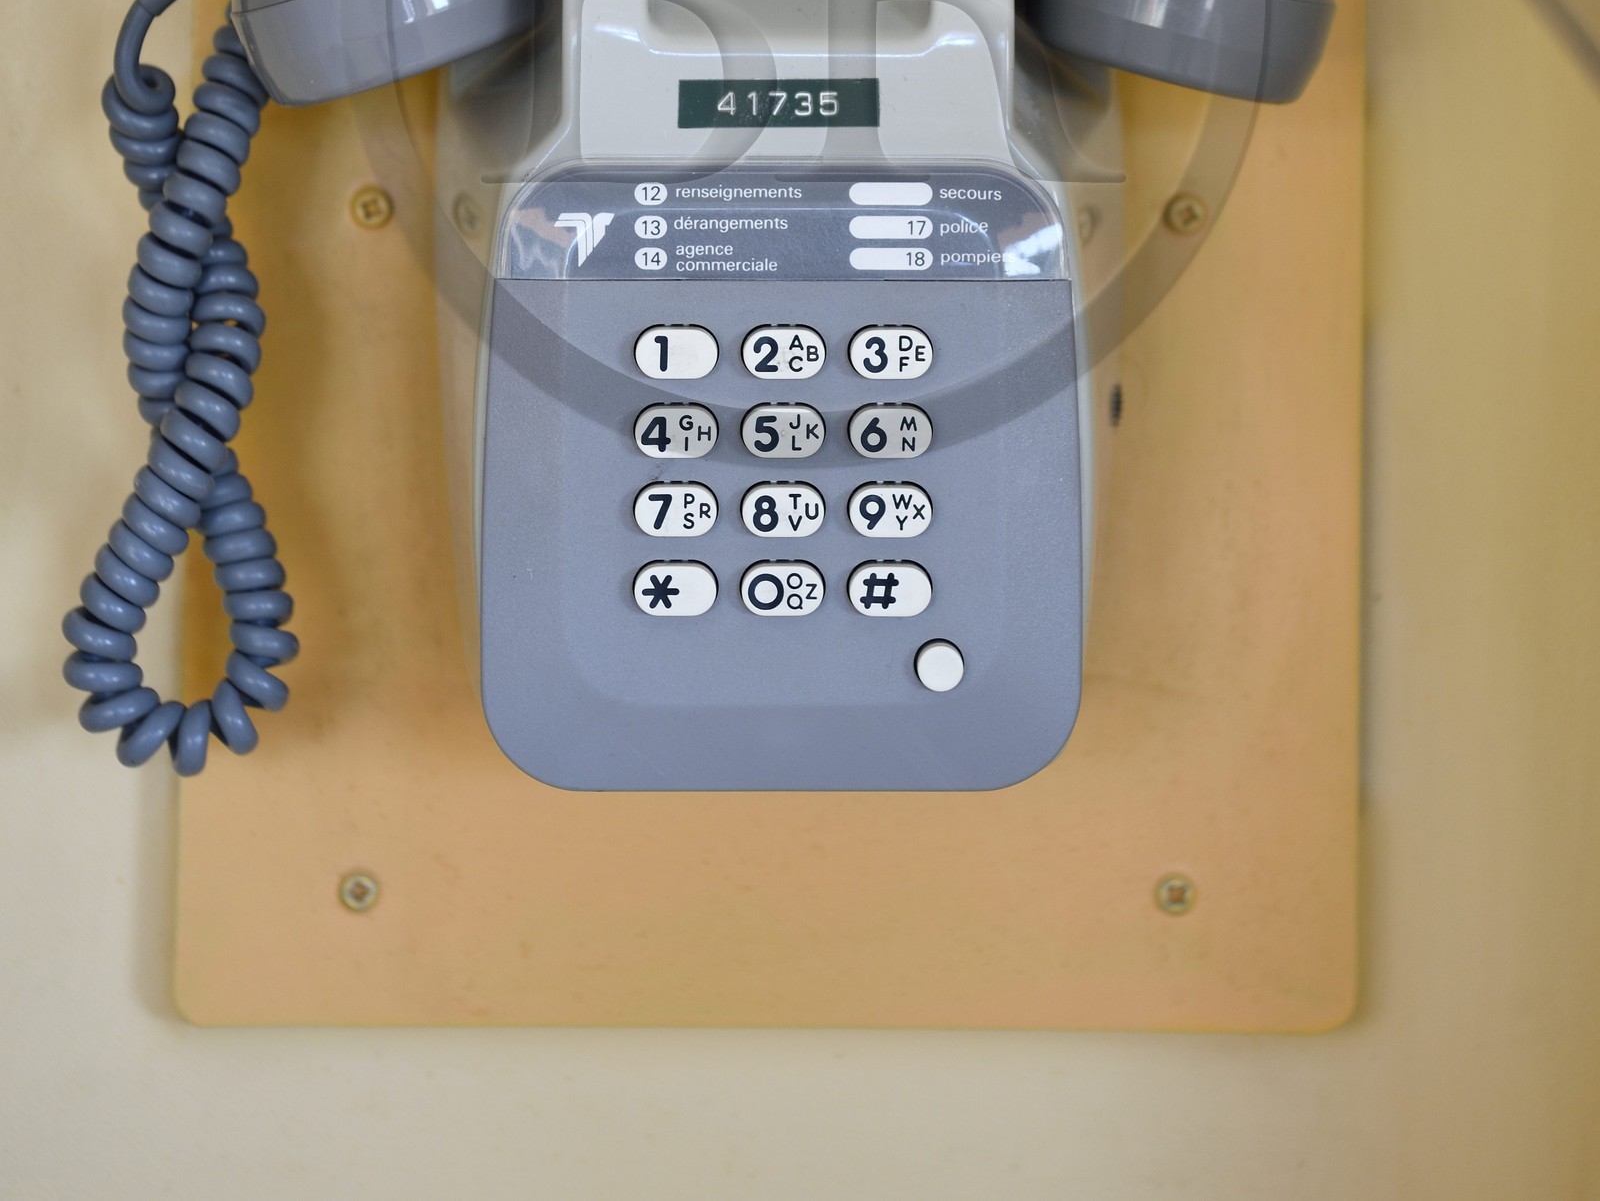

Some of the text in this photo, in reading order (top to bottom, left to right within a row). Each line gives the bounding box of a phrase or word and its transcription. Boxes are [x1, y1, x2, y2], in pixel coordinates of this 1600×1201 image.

[717, 90, 838, 117] 41735
[642, 185, 803, 202] 12 renseignements
[939, 187, 1003, 201] secours
[642, 216, 789, 236] 13 dérangements
[907, 219, 989, 237] 17 police
[642, 244, 734, 266] 14 agence
[675, 257, 779, 272] commerciale
[906, 251, 926, 267] 18
[654, 335, 669, 372] 1
[753, 336, 779, 373] 2
[863, 336, 888, 374] 3
[640, 416, 672, 453] 4
[753, 415, 780, 453] 5
[860, 417, 888, 453] 6
[648, 493, 673, 530] 7
[752, 495, 779, 533] 8
[859, 494, 886, 531] 9
